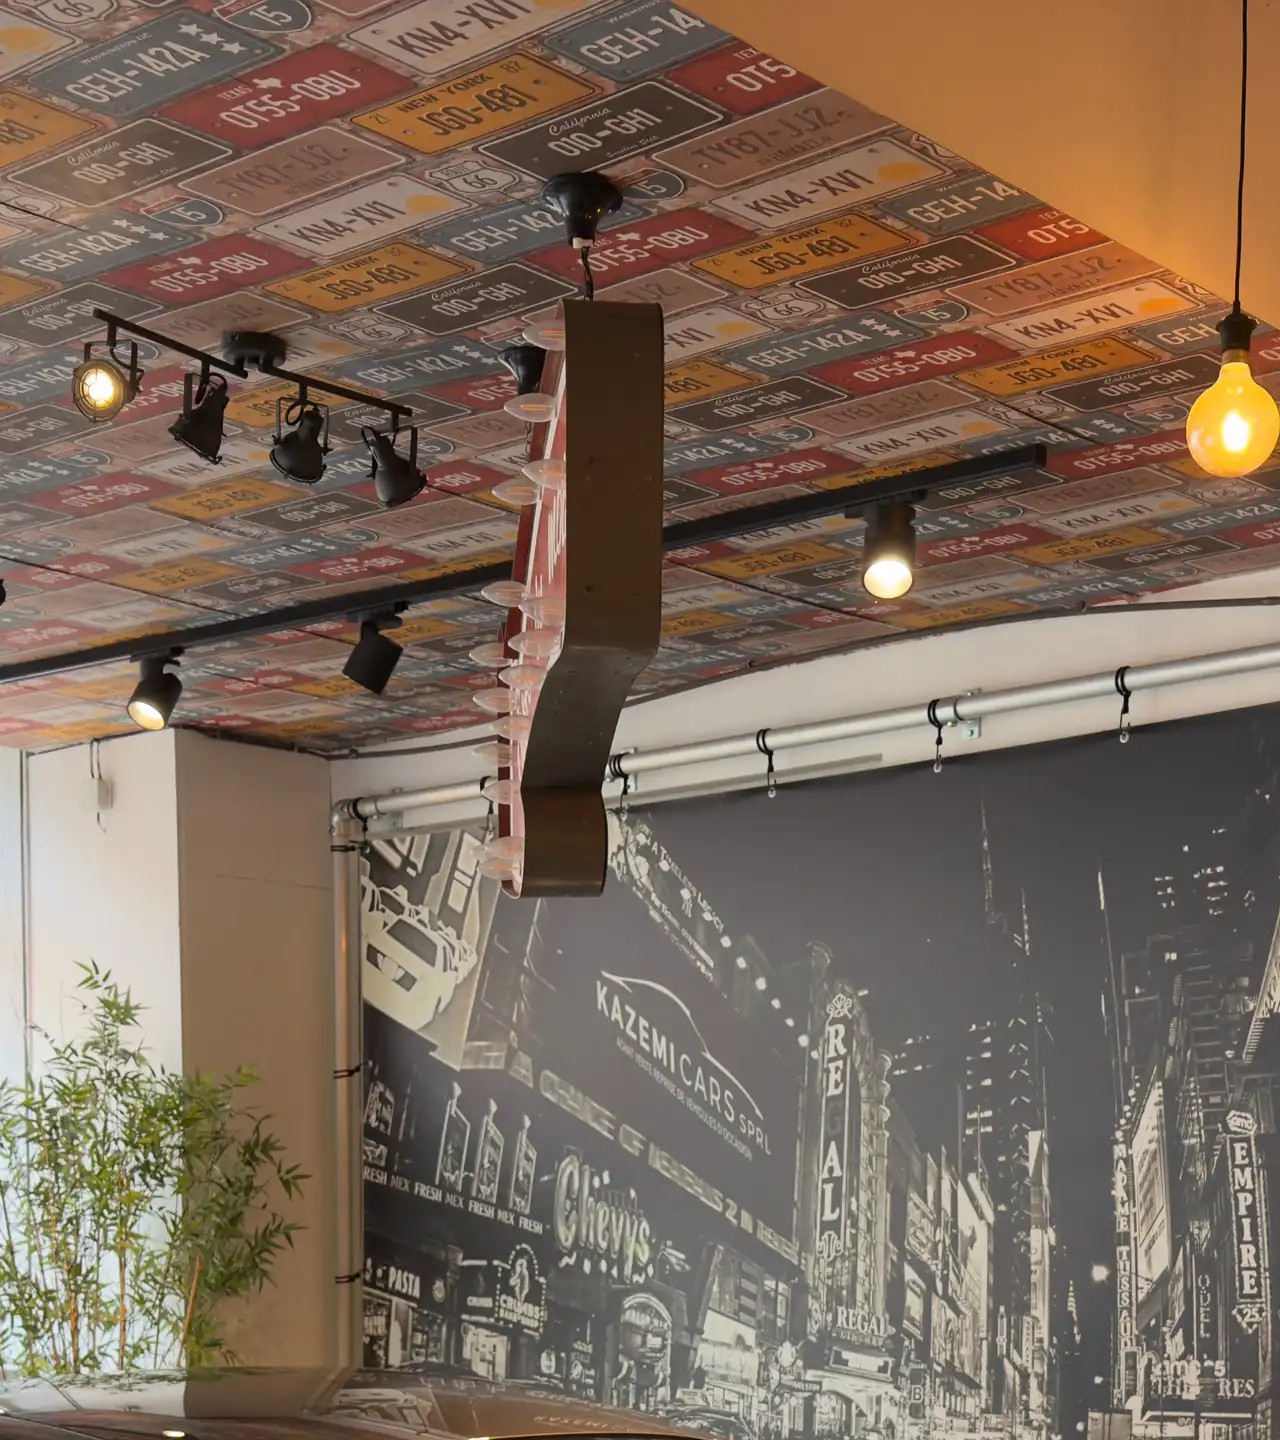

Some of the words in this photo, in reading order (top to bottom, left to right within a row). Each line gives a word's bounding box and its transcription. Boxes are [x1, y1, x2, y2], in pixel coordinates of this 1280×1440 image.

[249, 6, 293, 26] 15
[66, 41, 211, 102] GEH-142A
[217, 86, 252, 100] TEXAS
[417, 84, 539, 135] JGO-481
[549, 107, 613, 136] California
[461, 174, 498, 188] 66
[170, 206, 206, 221] 15
[773, 304, 804, 316] 66
[921, 309, 951, 322] 15
[747, 329, 872, 369] GEH-142A
[597, 980, 675, 1073] KAZEMI
[680, 1054, 734, 1122] CARS
[739, 1114, 771, 1155] SPRL
[822, 1024, 847, 1221] REGAL
[390, 1175, 410, 1192] MEX
[414, 1182, 442, 1202] FRESH
[468, 1200, 494, 1219] FRESH
[497, 1210, 515, 1225] MEX
[519, 1216, 543, 1235] FRESH
[1234, 1143, 1258, 1295] EMPIRE
[388, 1266, 420, 1299] PASTA
[836, 1305, 888, 1337] REGAL
[1243, 1308, 1259, 1322] 25
